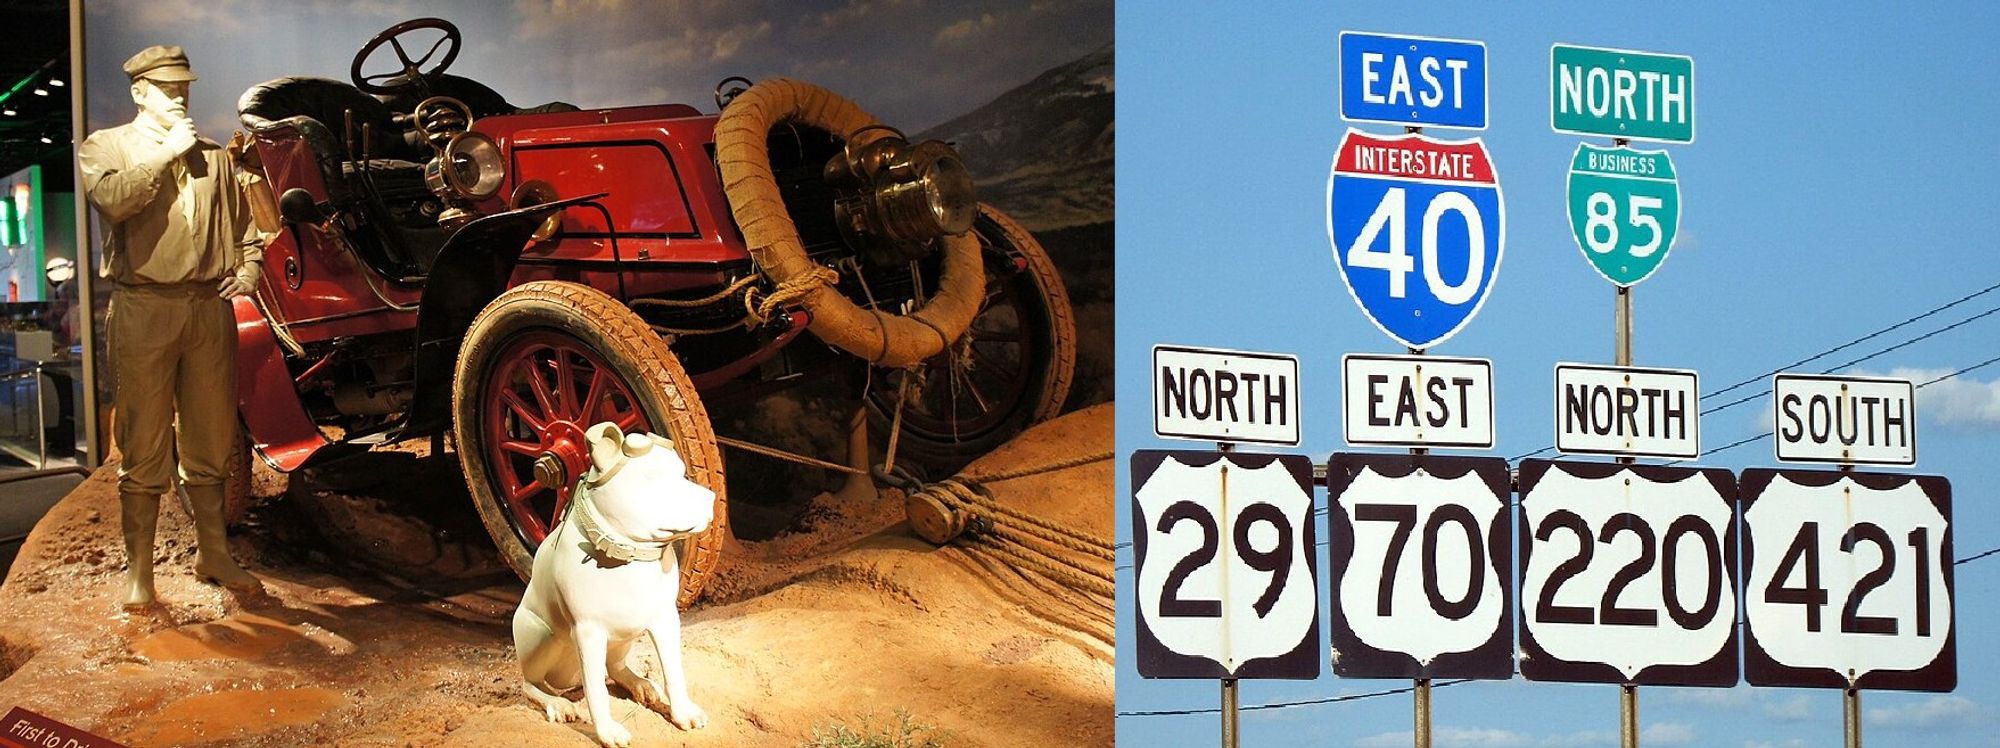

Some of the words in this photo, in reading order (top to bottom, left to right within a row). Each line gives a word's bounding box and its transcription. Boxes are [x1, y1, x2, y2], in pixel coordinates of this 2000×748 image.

[1361, 52, 1468, 109] EAST
[1560, 64, 1686, 124] NORTH
[1355, 145, 1474, 179] INTERSTATE
[1589, 152, 1656, 175] BUSINESS
[1347, 187, 1485, 305] 40
[1585, 192, 1663, 258] 85
[1163, 366, 1287, 426] NORTH
[1368, 376, 1473, 428] EAST
[1566, 383, 1686, 440] NORTH
[1781, 393, 1907, 448] SOUTH
[1157, 500, 1293, 619] 29
[1354, 503, 1485, 620] 70
[1535, 509, 1723, 630] 220
[1765, 521, 1931, 637] 421
[9, 719, 46, 742] First
[42, 730, 61, 748] to
